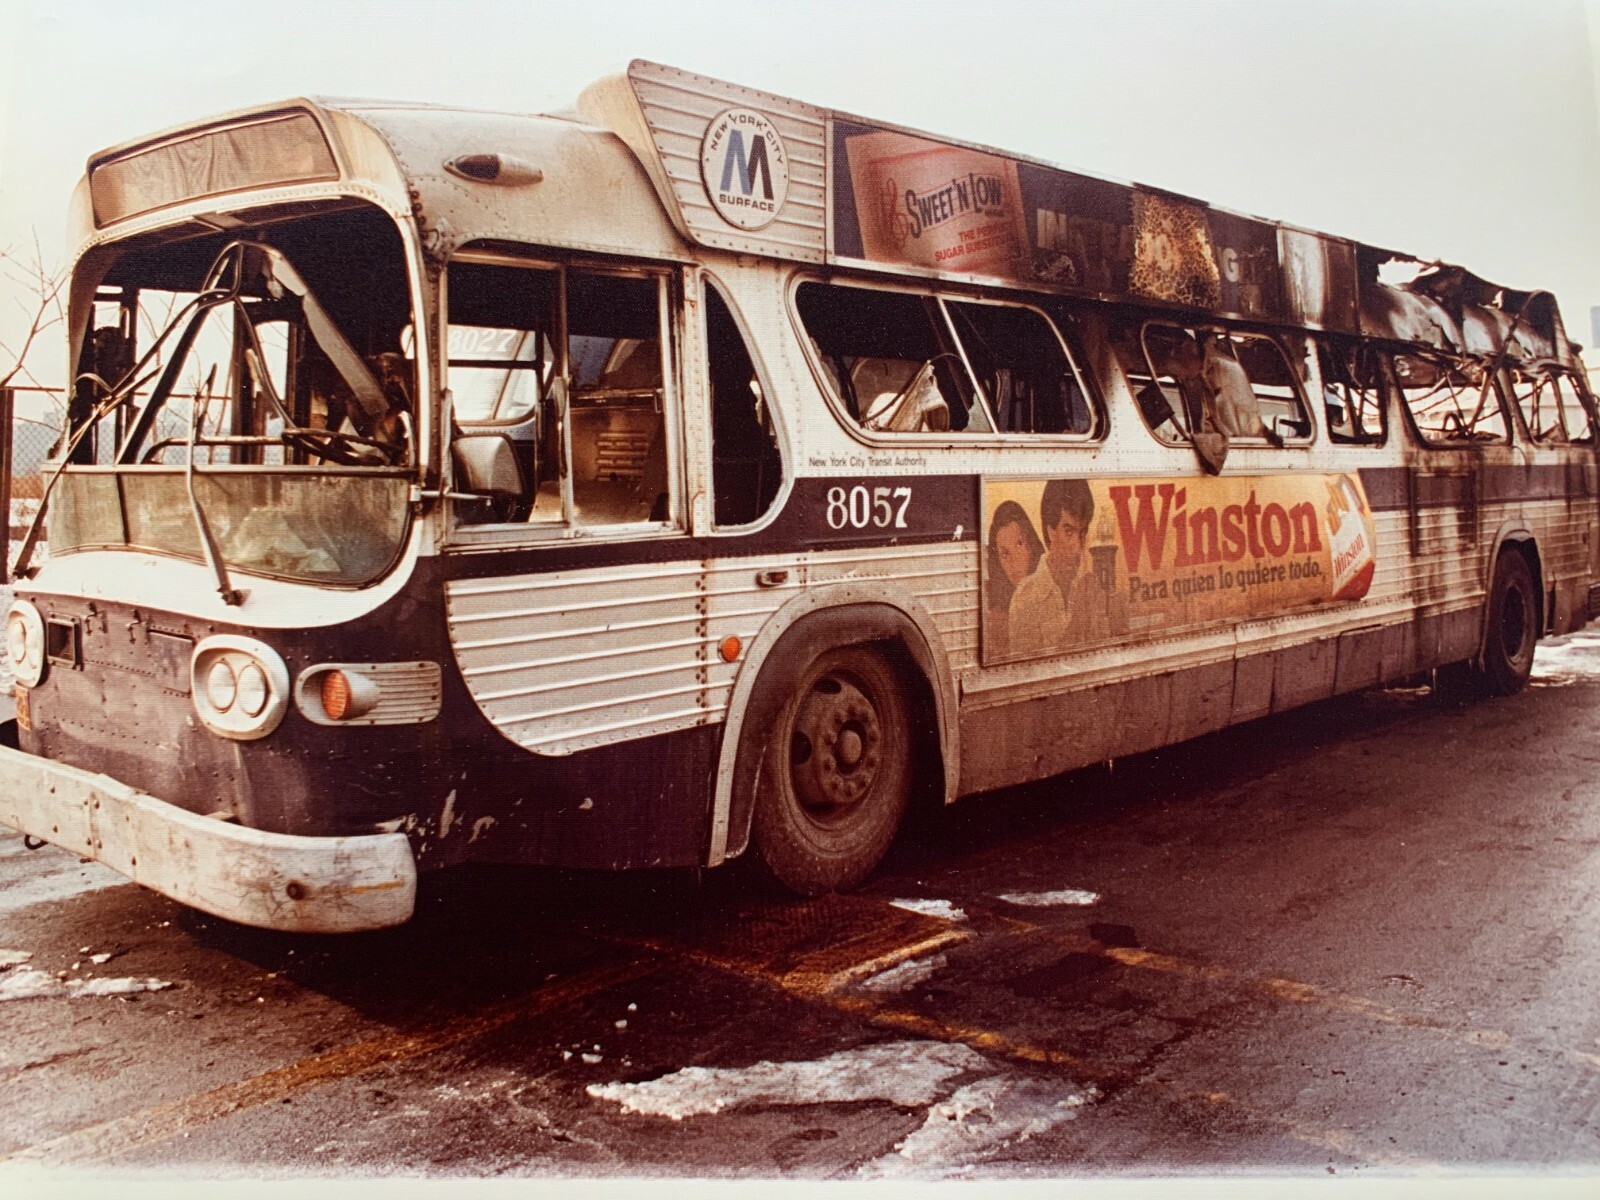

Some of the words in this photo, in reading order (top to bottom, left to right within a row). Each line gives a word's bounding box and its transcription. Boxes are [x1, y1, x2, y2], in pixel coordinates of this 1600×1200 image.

[710, 121, 728, 151] NEW
[728, 114, 765, 131] YORK
[765, 130, 784, 164] CITY
[720, 129, 775, 201] M
[719, 193, 775, 212] SURFACE
[968, 172, 1002, 213] LOW
[934, 245, 965, 262] SUGAR
[957, 229, 975, 242] THE
[809, 457, 827, 467] New
[829, 457, 847, 467] York
[849, 456, 866, 468] City
[868, 456, 893, 467] Transit
[894, 455, 927, 468] Authority
[826, 485, 913, 530] 8057
[1109, 483, 1323, 572] Winston
[1333, 533, 1365, 578] Winston
[1128, 576, 1168, 603] Para
[1172, 570, 1216, 601] quien
[1218, 565, 1234, 591] lo
[1236, 562, 1286, 593] quiere
